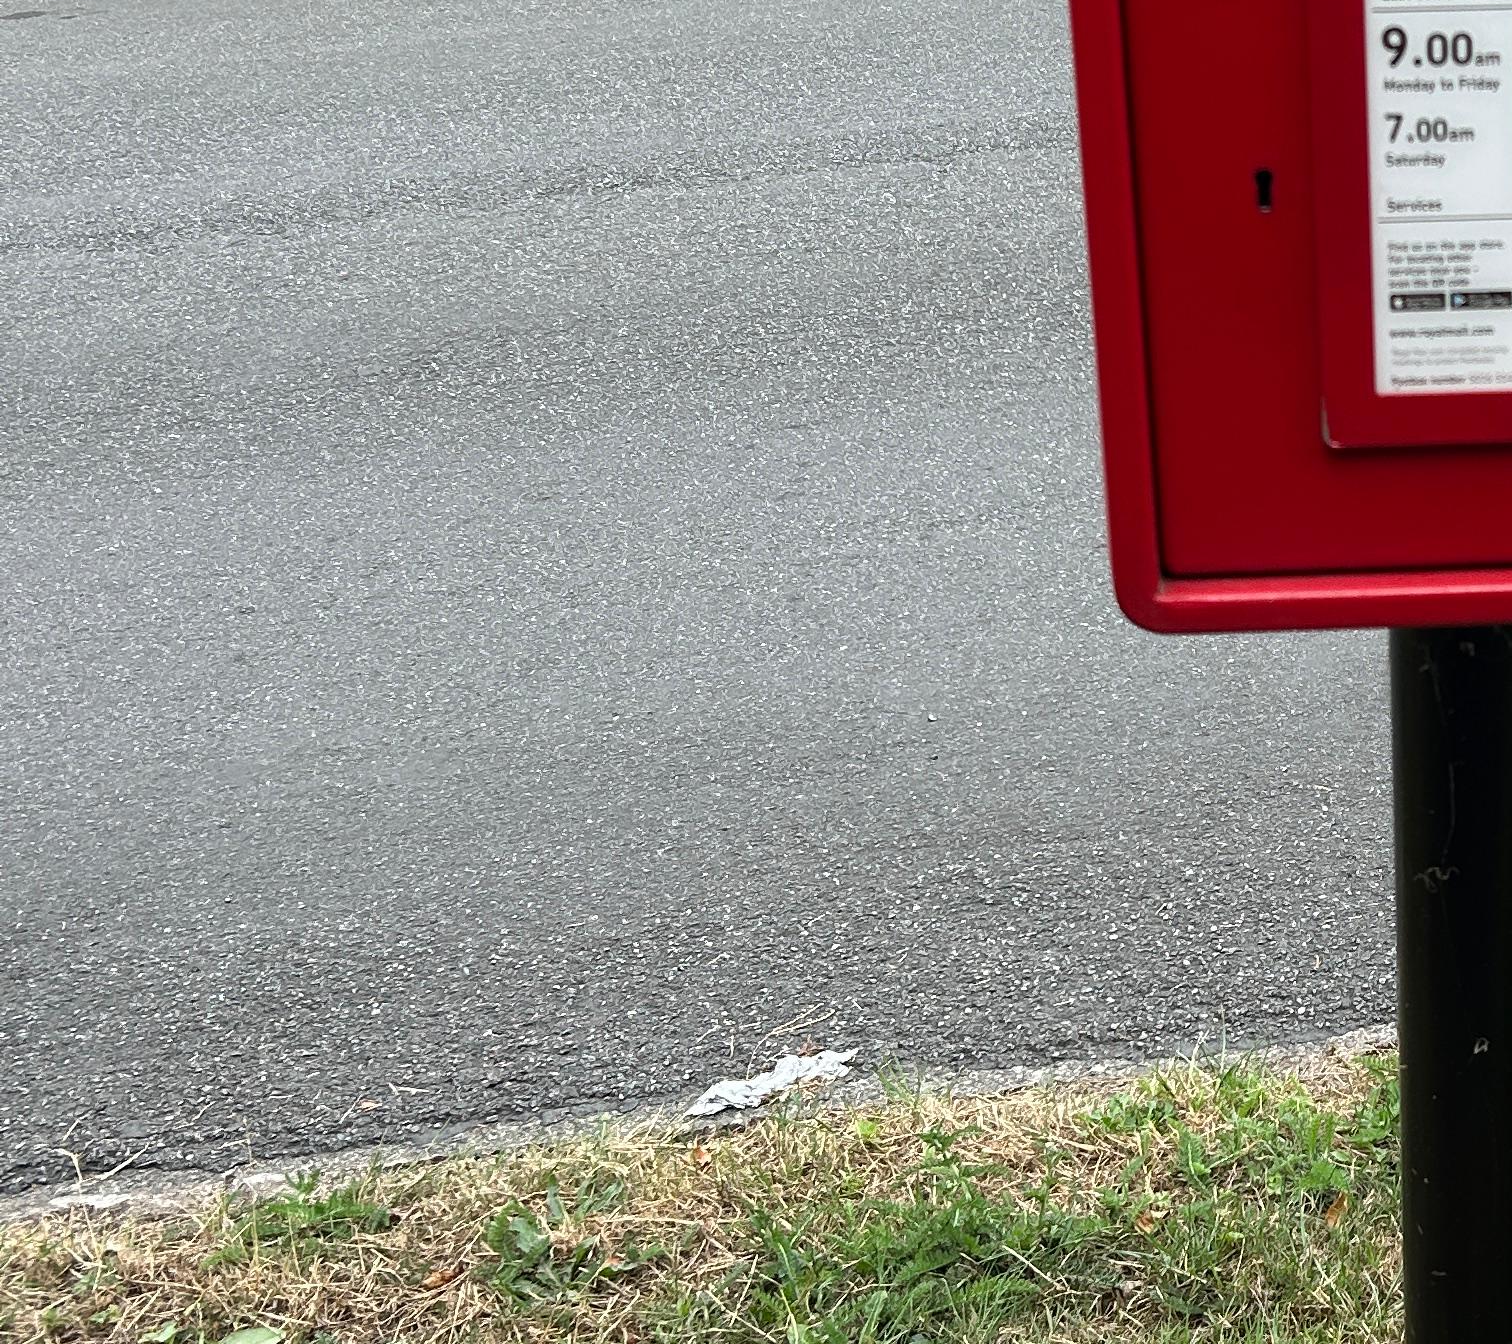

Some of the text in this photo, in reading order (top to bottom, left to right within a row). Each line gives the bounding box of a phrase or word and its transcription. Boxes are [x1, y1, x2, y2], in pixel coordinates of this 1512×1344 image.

[1382, 26, 1501, 68] 9.00am
[1384, 77, 1500, 94] Monday to Friday
[1384, 113, 1475, 143] 7.00am
[1385, 152, 1445, 168] Saturday
[1387, 198, 1442, 213] Services
